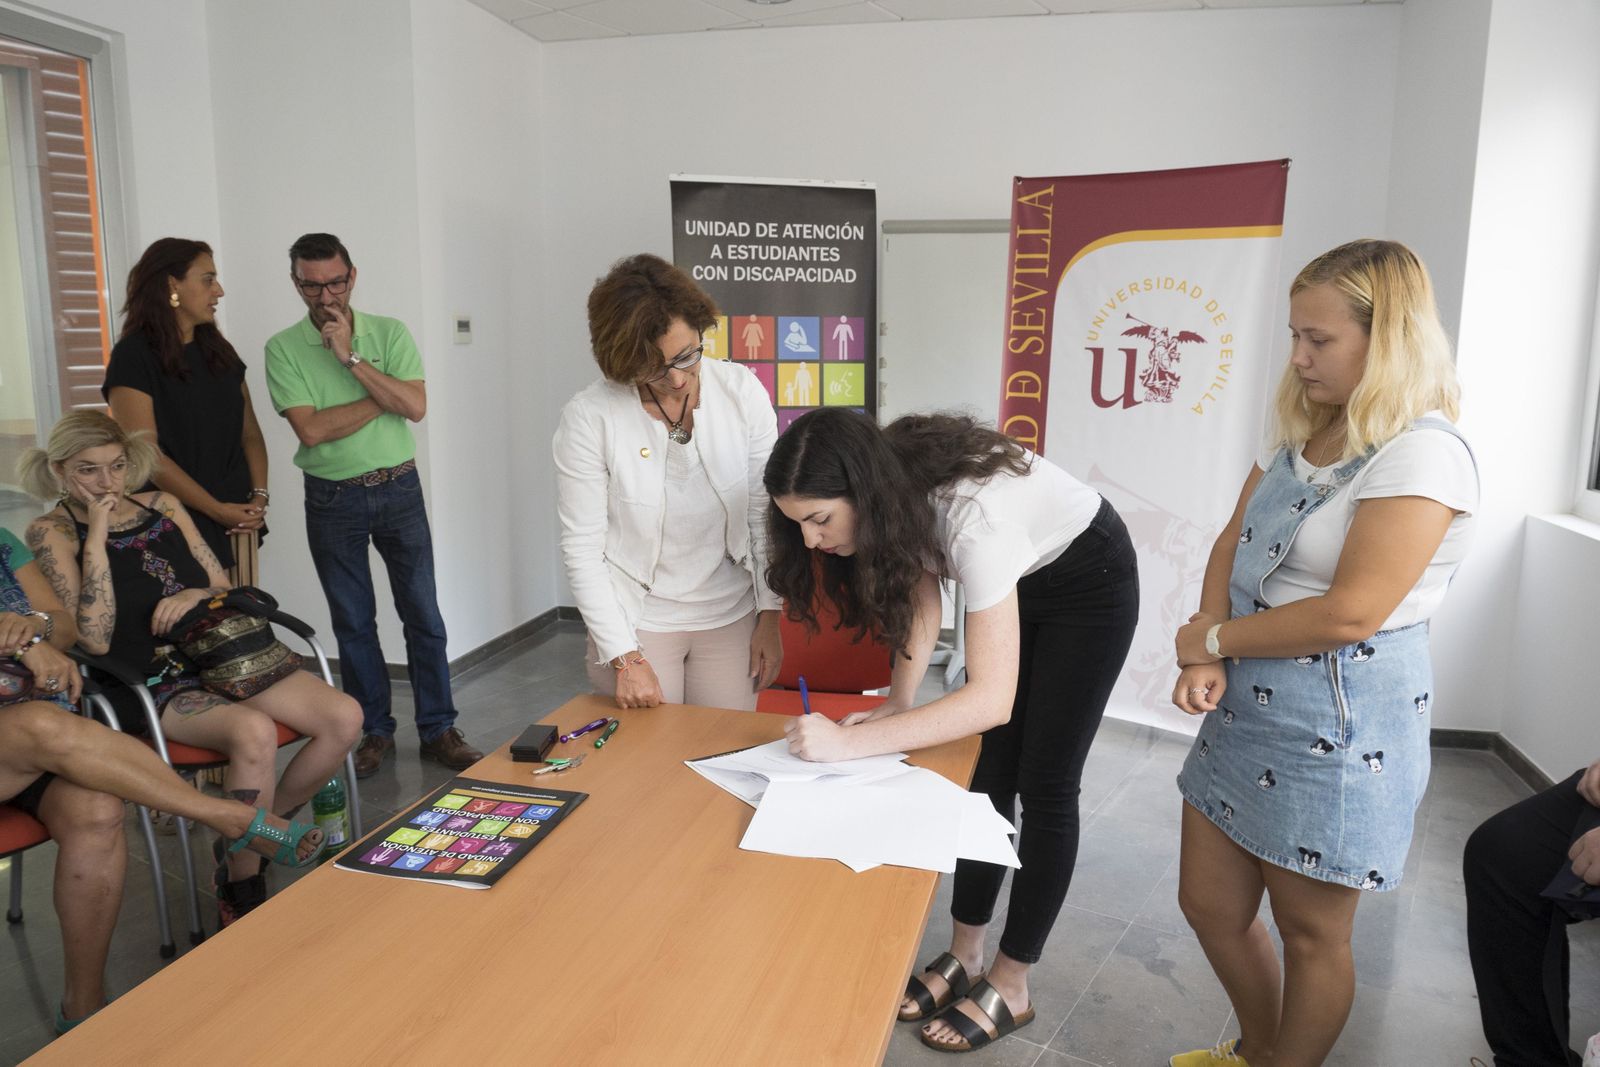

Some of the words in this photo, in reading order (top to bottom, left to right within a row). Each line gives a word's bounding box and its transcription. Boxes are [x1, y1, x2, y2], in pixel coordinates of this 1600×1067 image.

[685, 219, 751, 237] UNIDAD
[755, 222, 778, 239] DE
[782, 221, 865, 241] ATENCIÓN
[710, 244, 723, 259] A
[727, 244, 841, 262] ESTUDIANTES
[692, 265, 728, 281] CON
[733, 266, 857, 284] DISCAPACIDAD
[1008, 184, 1055, 356] SEVILLA
[1086, 276, 1203, 342] UNIVERSIDAD
[1203, 298, 1228, 327] DE
[1190, 333, 1235, 417] SEVILLA
[432, 806, 513, 824] DISCAPACIDAD
[513, 816, 540, 826] CON
[419, 825, 497, 841] ESTUDIANTES
[438, 849, 457, 859] DE
[457, 852, 504, 864] UNIDAD
